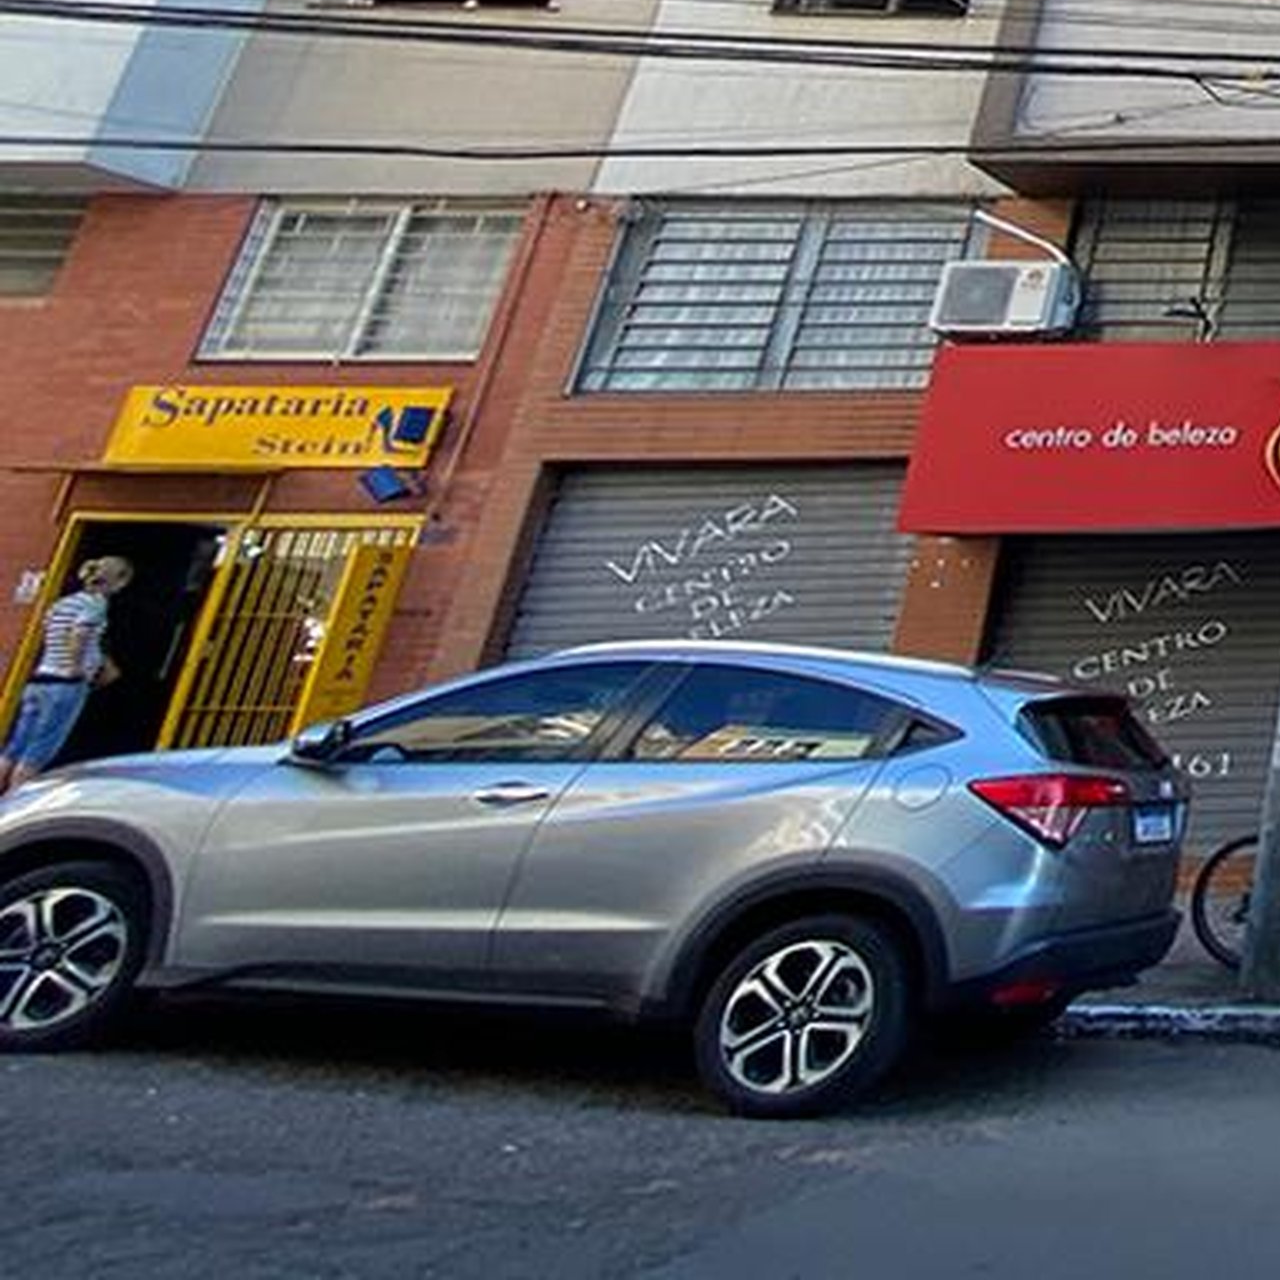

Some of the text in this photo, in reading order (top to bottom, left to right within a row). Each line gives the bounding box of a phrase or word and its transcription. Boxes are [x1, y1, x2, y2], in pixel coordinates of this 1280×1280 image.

[142, 389, 371, 428] Sapataria
[252, 433, 368, 456] Stein
[1004, 419, 1238, 449] centro de beleza
[605, 494, 799, 584] VIVARA
[1084, 560, 1243, 622] VIVARA
[1072, 620, 1227, 680] CENTRO
